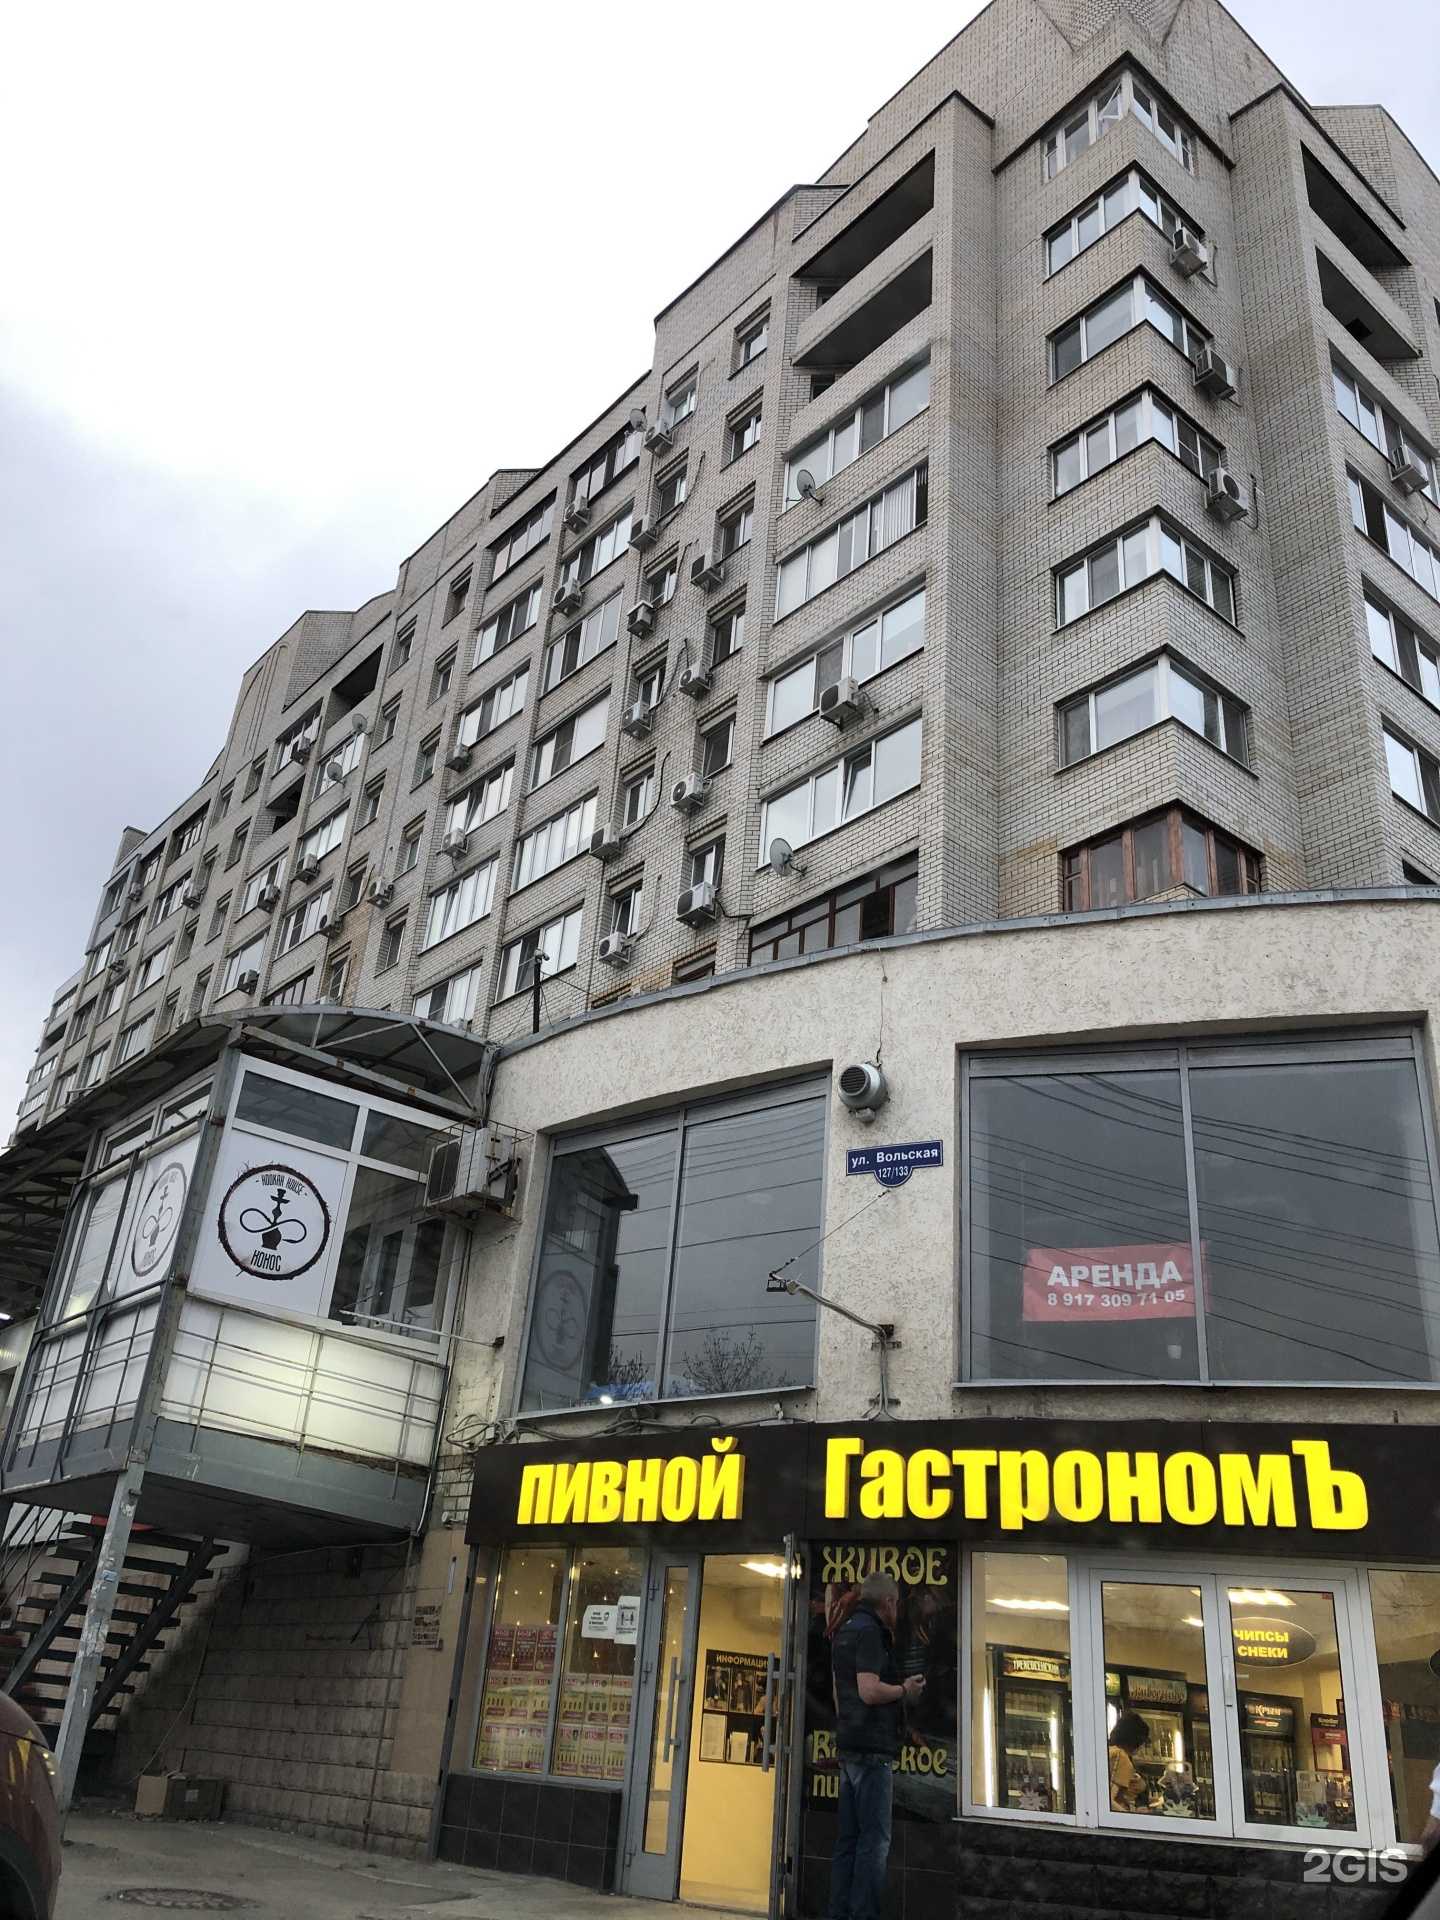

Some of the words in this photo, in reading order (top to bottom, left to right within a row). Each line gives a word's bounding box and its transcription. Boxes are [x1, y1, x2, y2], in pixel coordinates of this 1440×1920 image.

[851, 1156, 870, 1168] ул.
[876, 1148, 938, 1163] Вольская
[878, 1166, 909, 1178] 127/133
[1047, 1260, 1184, 1290] АРЕНДА
[1047, 1292, 1058, 1306] 8
[1063, 1292, 1095, 1307] 917
[1100, 1293, 1132, 1308] 309
[1137, 1291, 1157, 1306] 71
[1164, 1289, 1186, 1303] 05
[1233, 1629, 1290, 1643] ЧИПСЫ
[1237, 1645, 1289, 1659] СНЕКИ
[715, 1654, 770, 1668] ИНФОРМАЦИ
